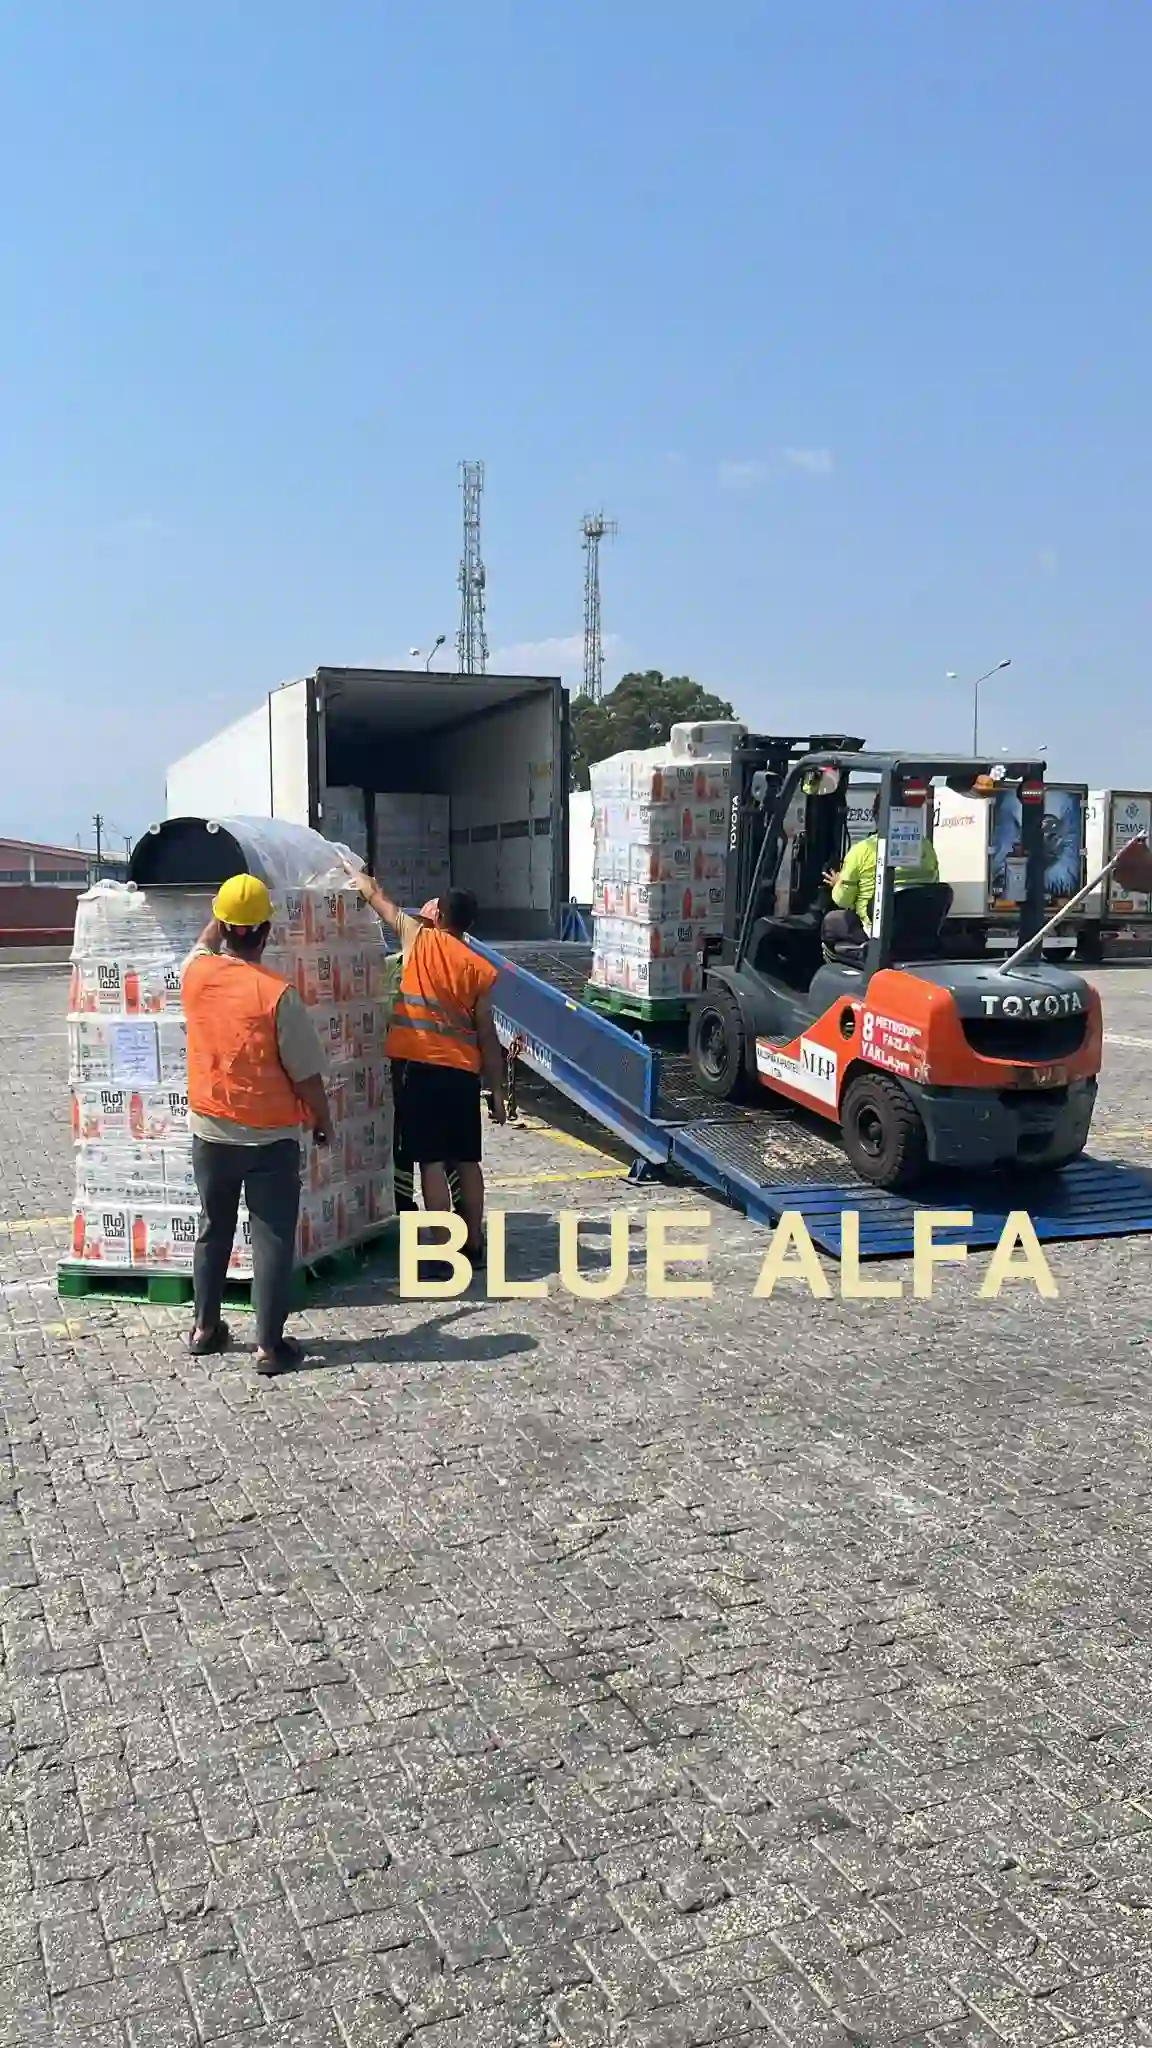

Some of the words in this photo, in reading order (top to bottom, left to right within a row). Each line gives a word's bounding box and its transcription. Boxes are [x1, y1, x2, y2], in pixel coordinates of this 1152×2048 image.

[730, 796, 740, 851] TOYOTA
[980, 991, 1082, 1017] TOYOTA
[862, 1012, 875, 1042] 8
